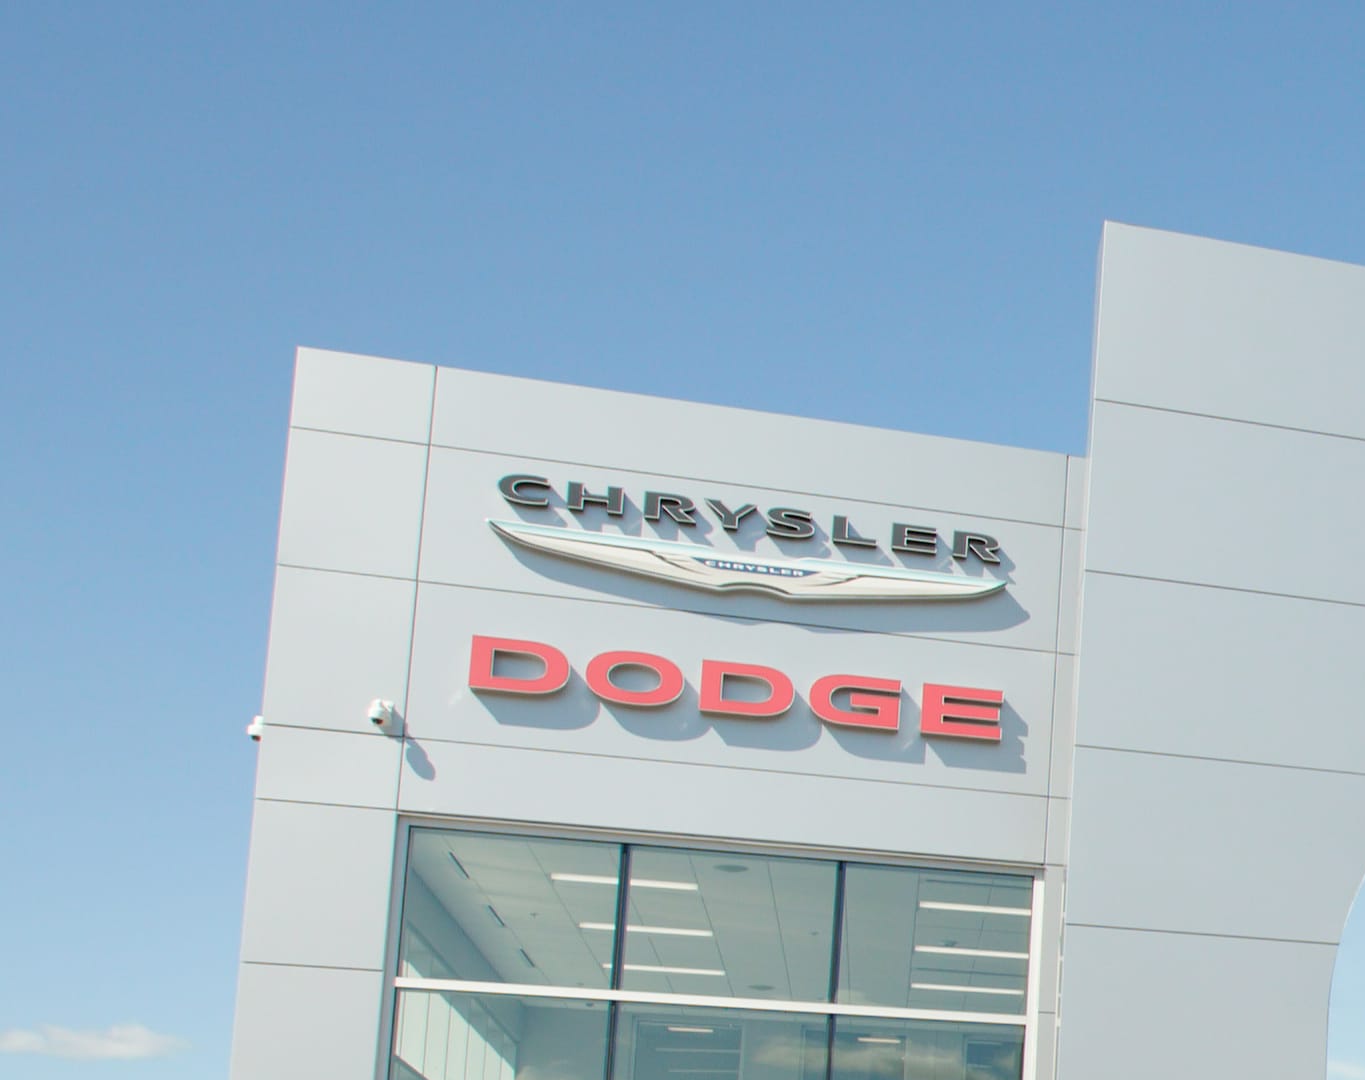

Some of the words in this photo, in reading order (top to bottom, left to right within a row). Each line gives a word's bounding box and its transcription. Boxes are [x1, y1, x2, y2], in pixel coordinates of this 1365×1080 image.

[497, 474, 1001, 563] CHRYSLER
[704, 560, 804, 577] CHRYSLER
[468, 635, 1004, 741] DODGE
